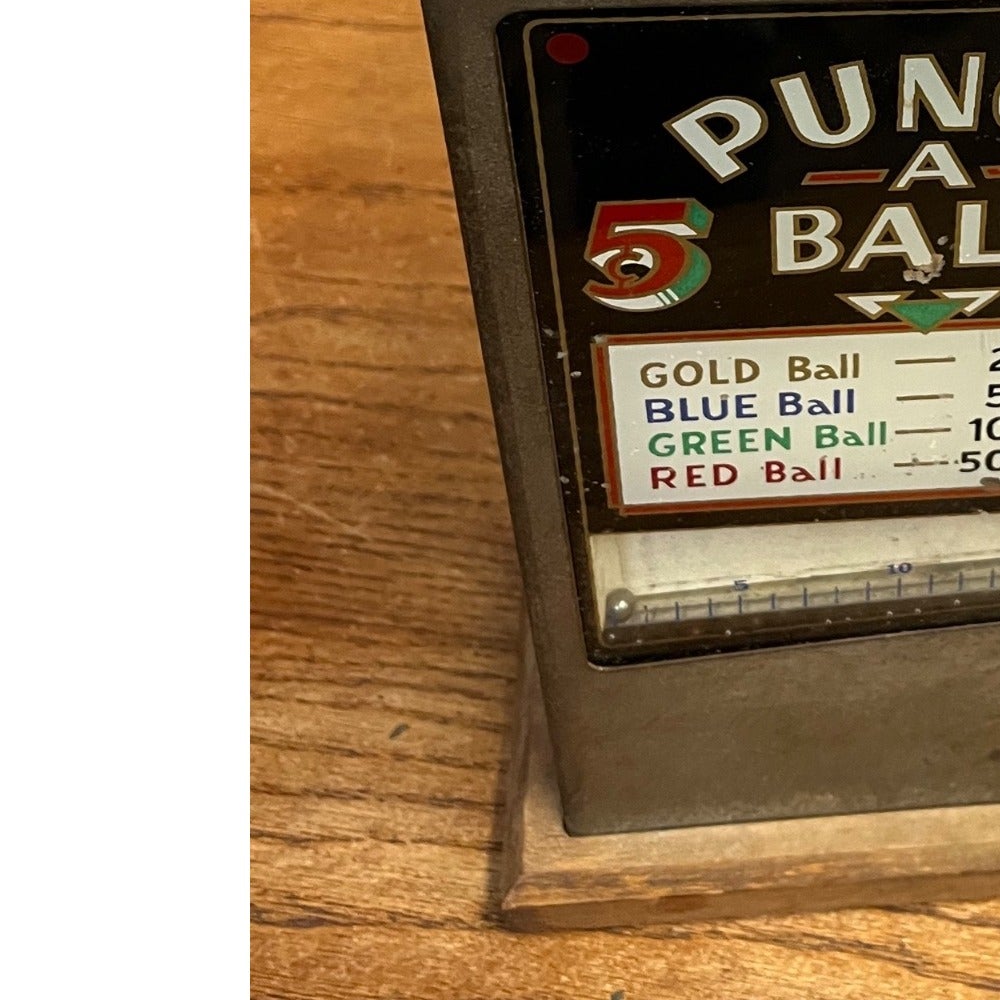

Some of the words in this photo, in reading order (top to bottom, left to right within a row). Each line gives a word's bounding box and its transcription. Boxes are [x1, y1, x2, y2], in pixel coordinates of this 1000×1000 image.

[888, 140, 975, 190] A
[640, 358, 760, 388] GOLD
[788, 353, 860, 382] Ball
[645, 394, 758, 423] BLUE
[778, 388, 855, 416] Ball
[648, 426, 791, 457] GREEN
[815, 421, 887, 449] Ball
[651, 463, 738, 489] RED
[765, 456, 841, 483] Ball
[733, 579, 749, 592] 5
[886, 561, 913, 574] 10
